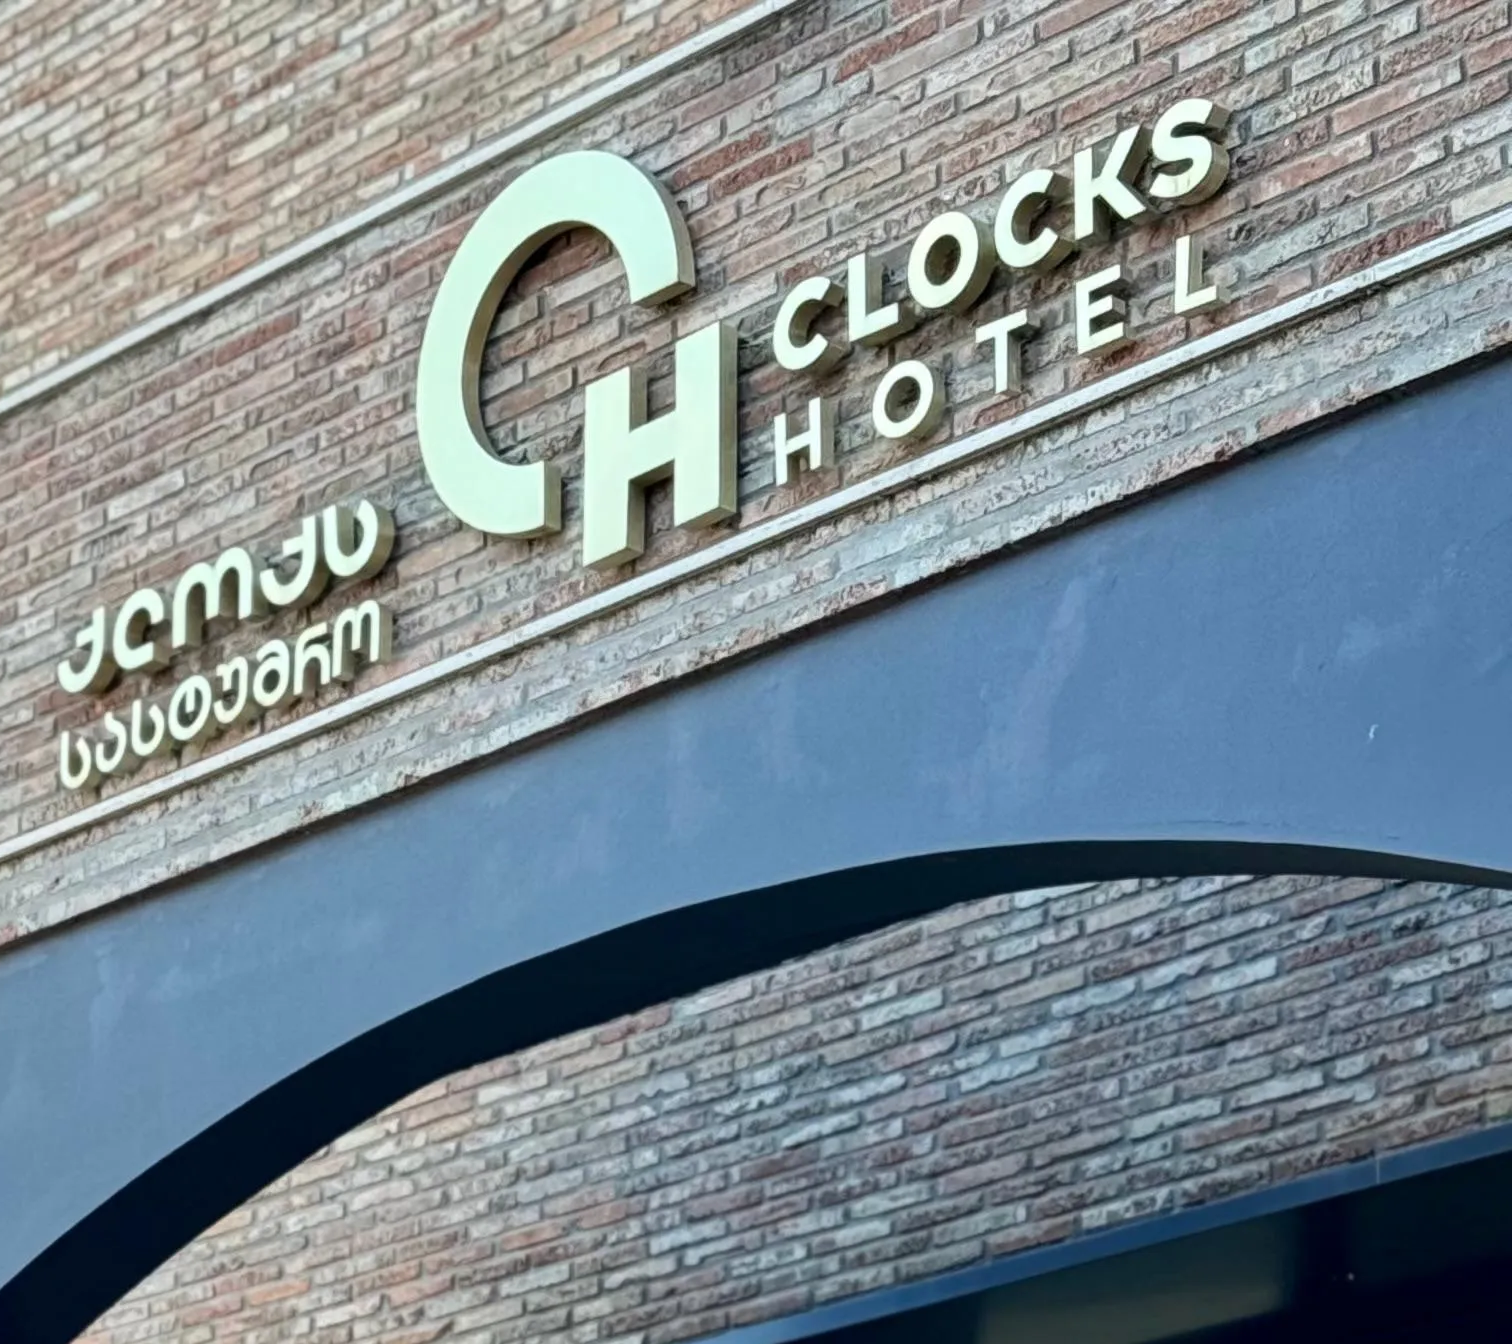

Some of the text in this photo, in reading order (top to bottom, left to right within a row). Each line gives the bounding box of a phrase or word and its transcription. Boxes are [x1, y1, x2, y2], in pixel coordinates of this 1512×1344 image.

[773, 98, 1222, 374] CLOCKS
[774, 236, 1216, 487] HOTEL
[57, 499, 379, 694] ქლოქს
[59, 600, 381, 790] სასტუმრო
